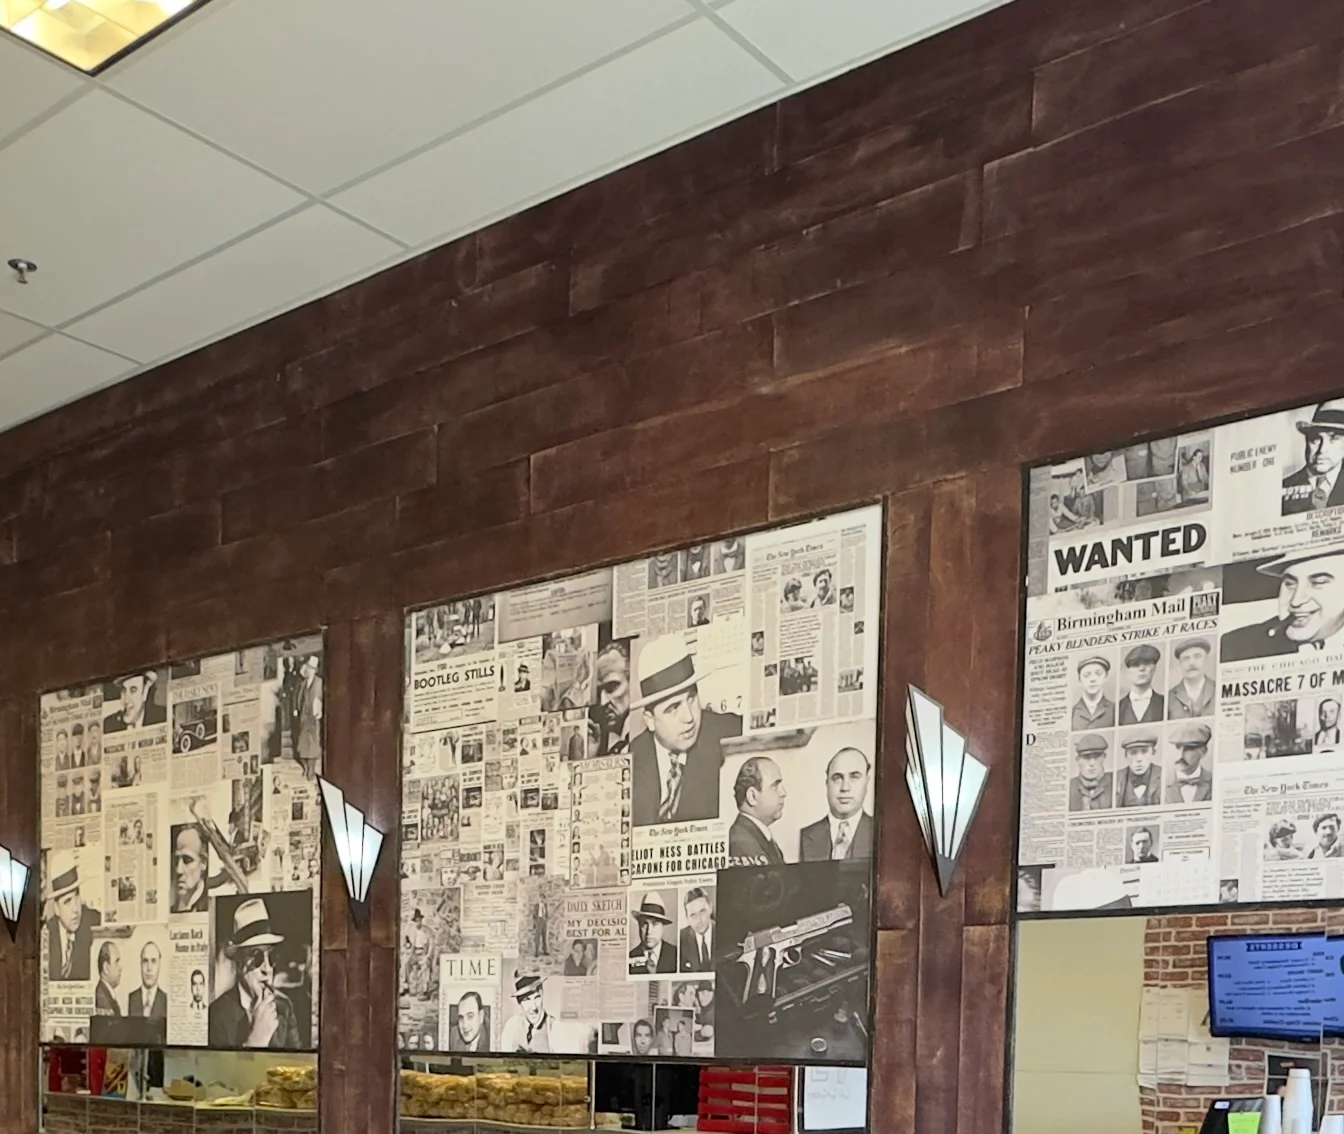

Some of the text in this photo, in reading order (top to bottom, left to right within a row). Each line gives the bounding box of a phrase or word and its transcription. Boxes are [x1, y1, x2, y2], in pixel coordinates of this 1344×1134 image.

[1230, 444, 1278, 462] PUBLIC ENEMY
[1229, 457, 1275, 474] NUMBER ONE
[1054, 523, 1207, 576] WANTED
[1057, 608, 1147, 633] Birmingham
[1151, 597, 1186, 617] Mail
[1028, 618, 1218, 656] PEAKY BLINDERS STRIKE AT RACES
[414, 672, 460, 690] BOOTLEG
[464, 665, 495, 681] STILLS
[1221, 676, 1291, 699] MASSACRE
[1297, 674, 1306, 690] 7
[1309, 671, 1327, 689] OF
[631, 841, 725, 861] ELIOT NESS BATTLES
[631, 856, 726, 876] CAPONE FOR CHICAGO
[566, 899, 623, 913] DAILY SKETCH
[566, 917, 628, 928] MY DECISIO
[566, 928, 628, 938] BEST FOR AL
[446, 957, 497, 977] TIME
